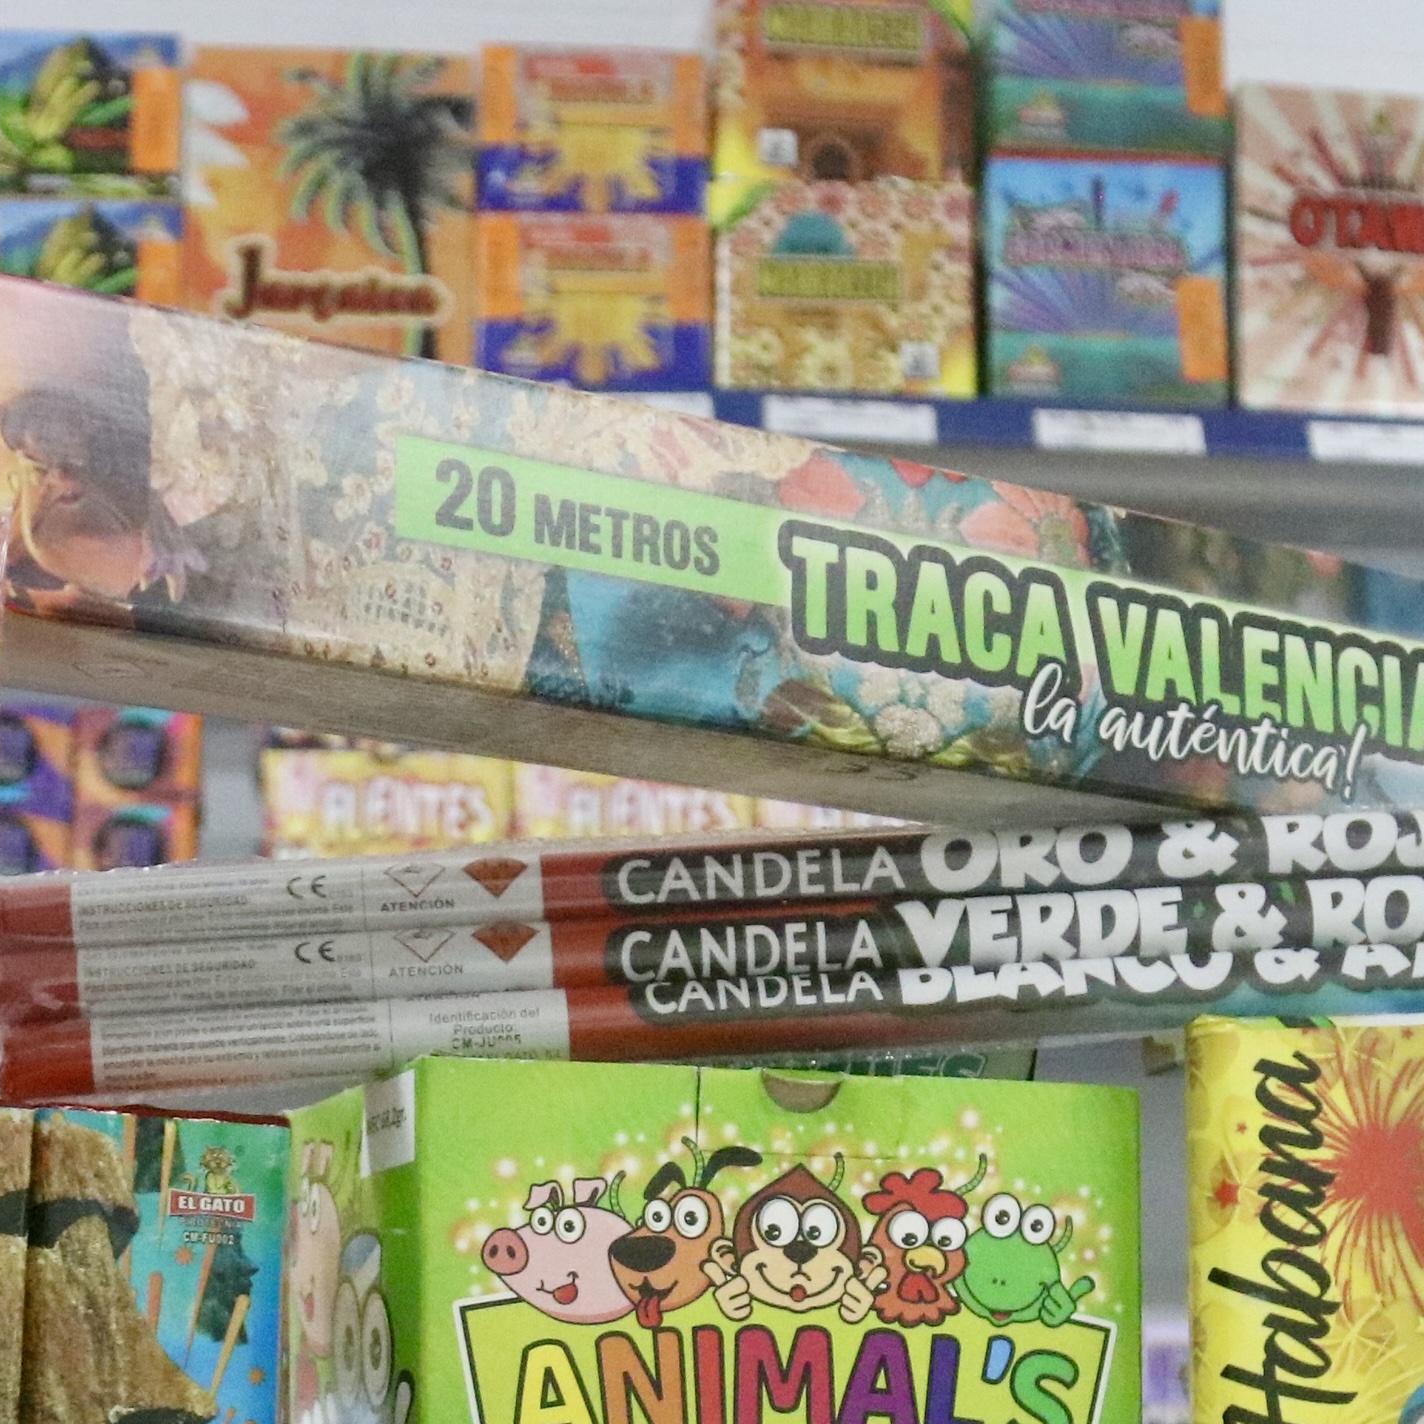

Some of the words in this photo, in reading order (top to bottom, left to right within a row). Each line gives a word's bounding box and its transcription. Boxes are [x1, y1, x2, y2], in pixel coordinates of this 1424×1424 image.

[434, 456, 517, 539] 20
[533, 491, 721, 578] METROS
[785, 526, 1075, 684] TRACA
[1022, 661, 1078, 742] la
[1098, 702, 1364, 798] auténtica!
[616, 844, 905, 905] CANDELA
[919, 820, 1133, 894] ORO
[1156, 818, 1239, 880] &
[380, 898, 456, 913] ATENCIÓN
[621, 919, 883, 985] CANDELA
[895, 886, 1185, 967] VERDE
[1212, 883, 1289, 955] &
[389, 964, 464, 979] ATENCIÓN
[643, 973, 883, 1014] CANDELA
[178, 1195, 197, 1210] EL
[199, 1196, 246, 1214] GATO
